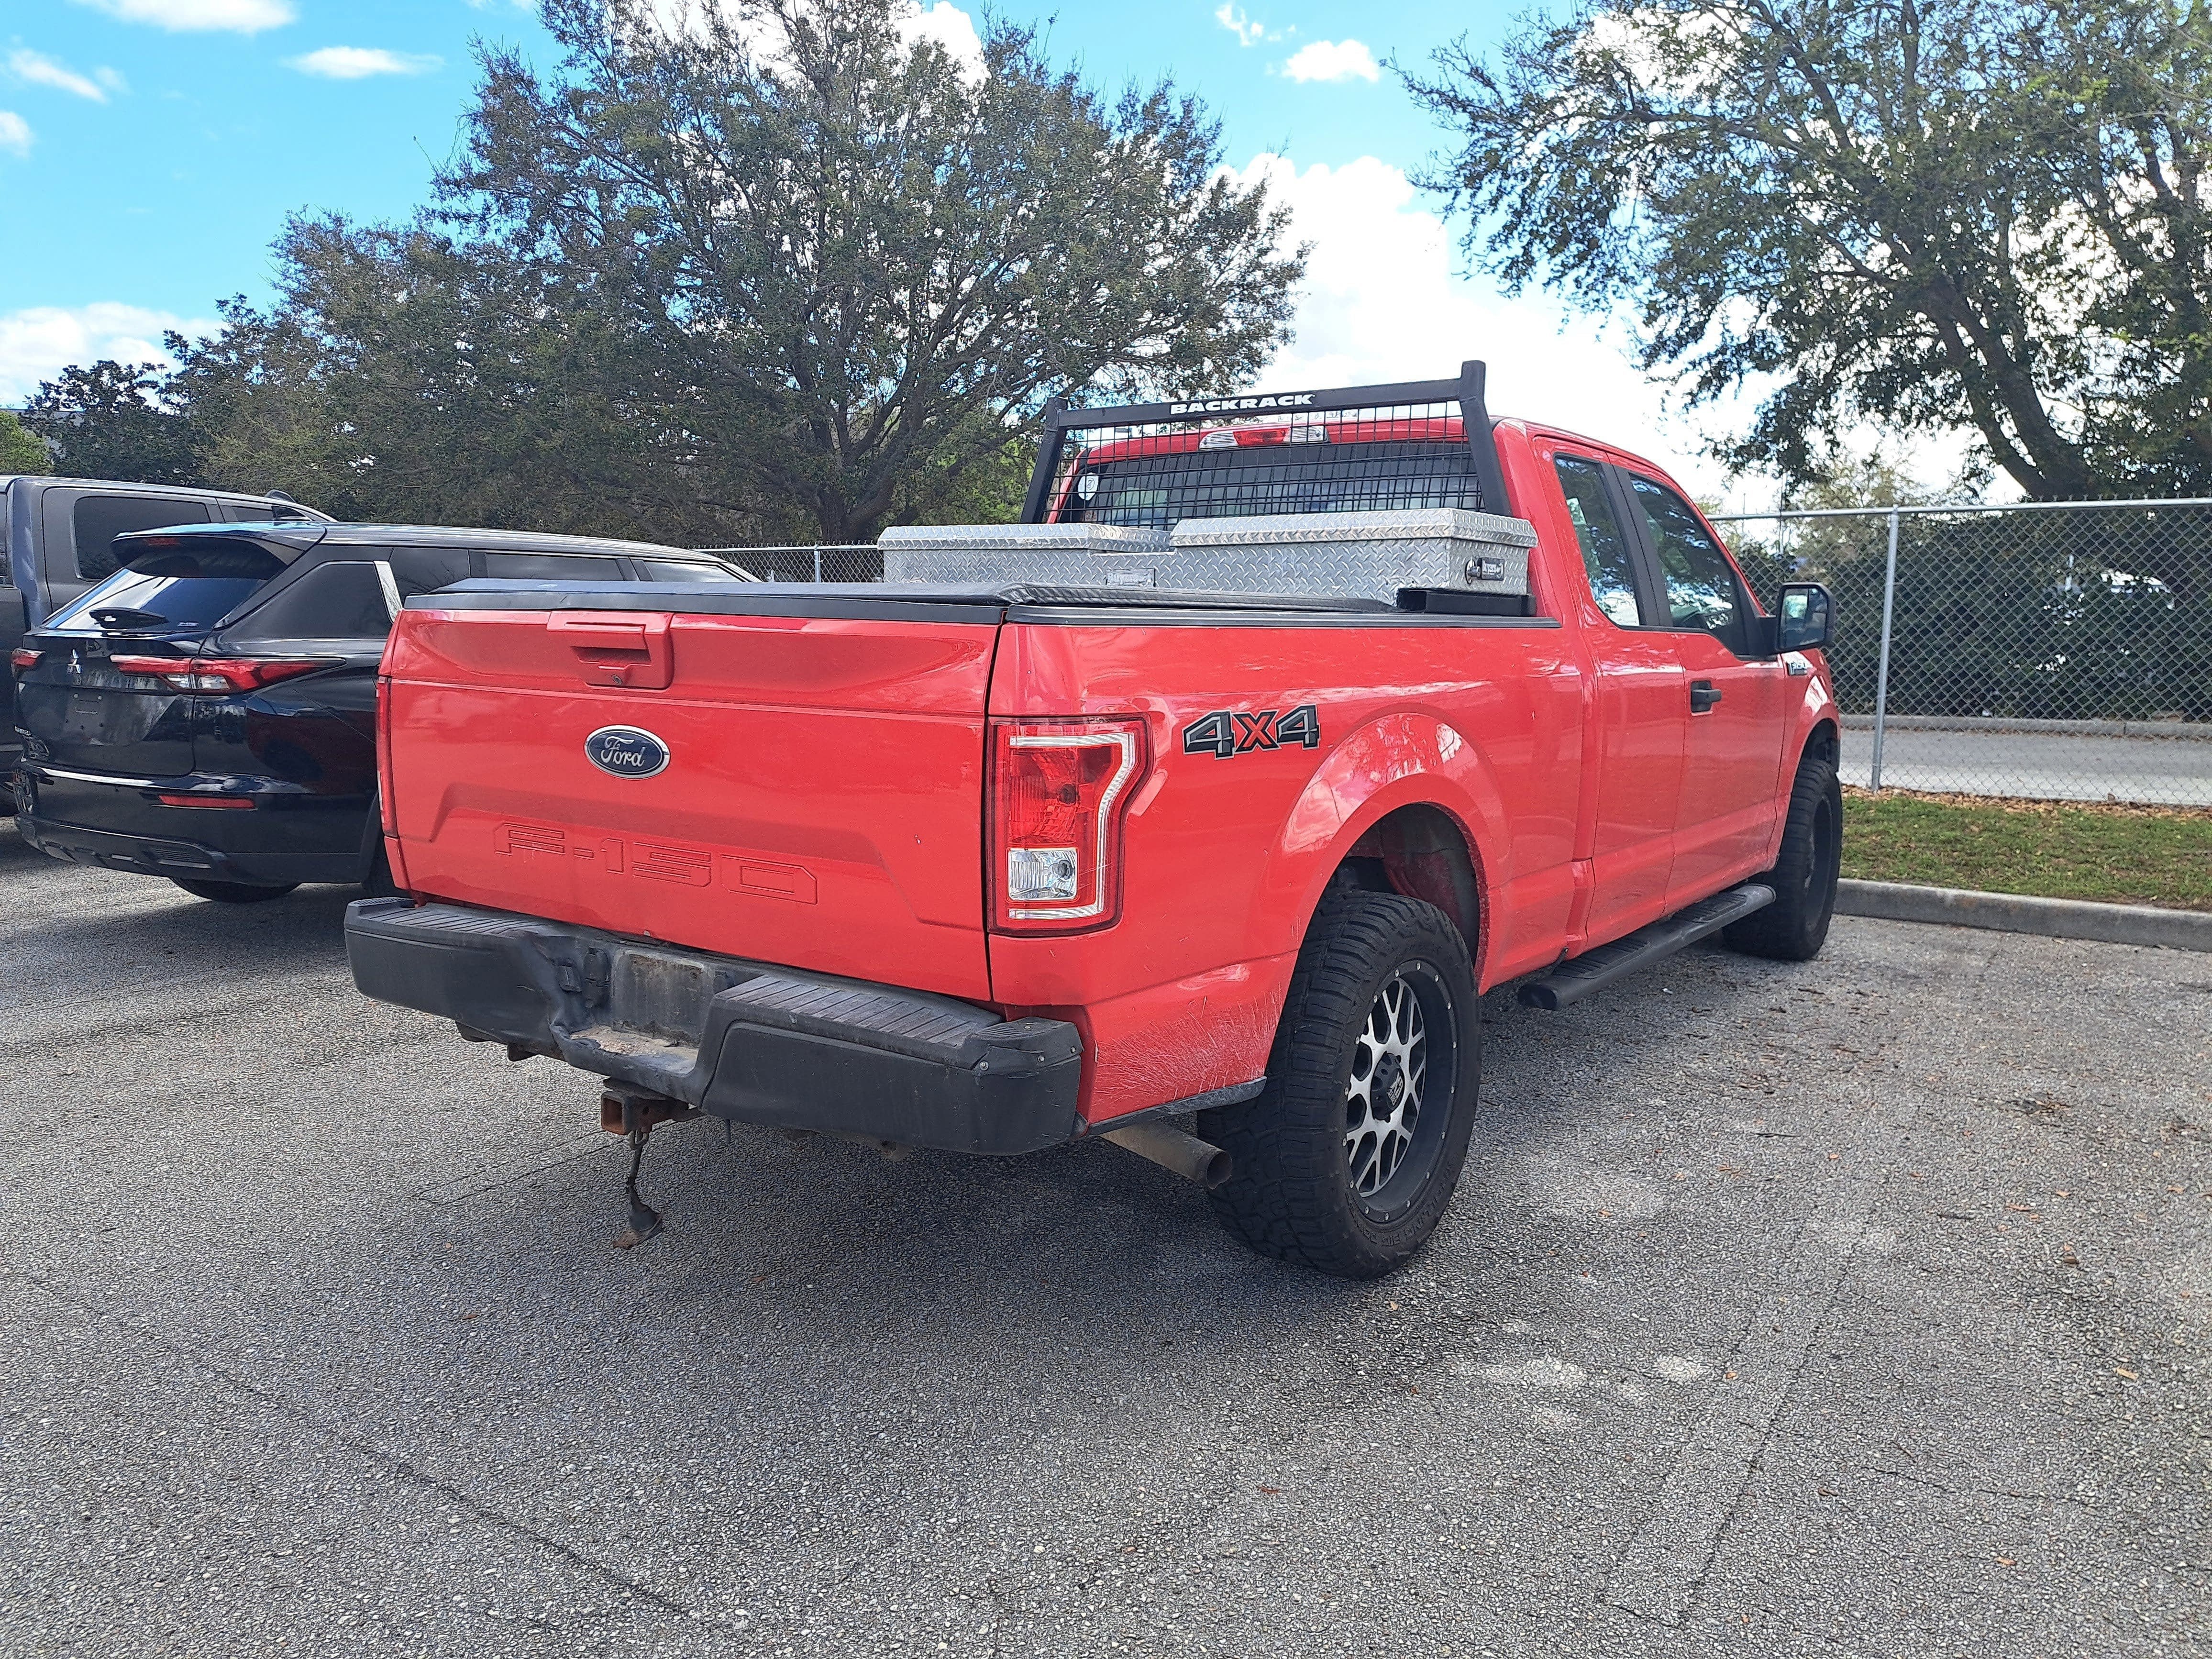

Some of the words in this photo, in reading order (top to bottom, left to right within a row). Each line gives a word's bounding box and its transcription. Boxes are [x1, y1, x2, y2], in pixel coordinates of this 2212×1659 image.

[1171, 394, 1314, 414] BACKRACK
[600, 736, 645, 767] Ford
[494, 822, 818, 906] F-150
